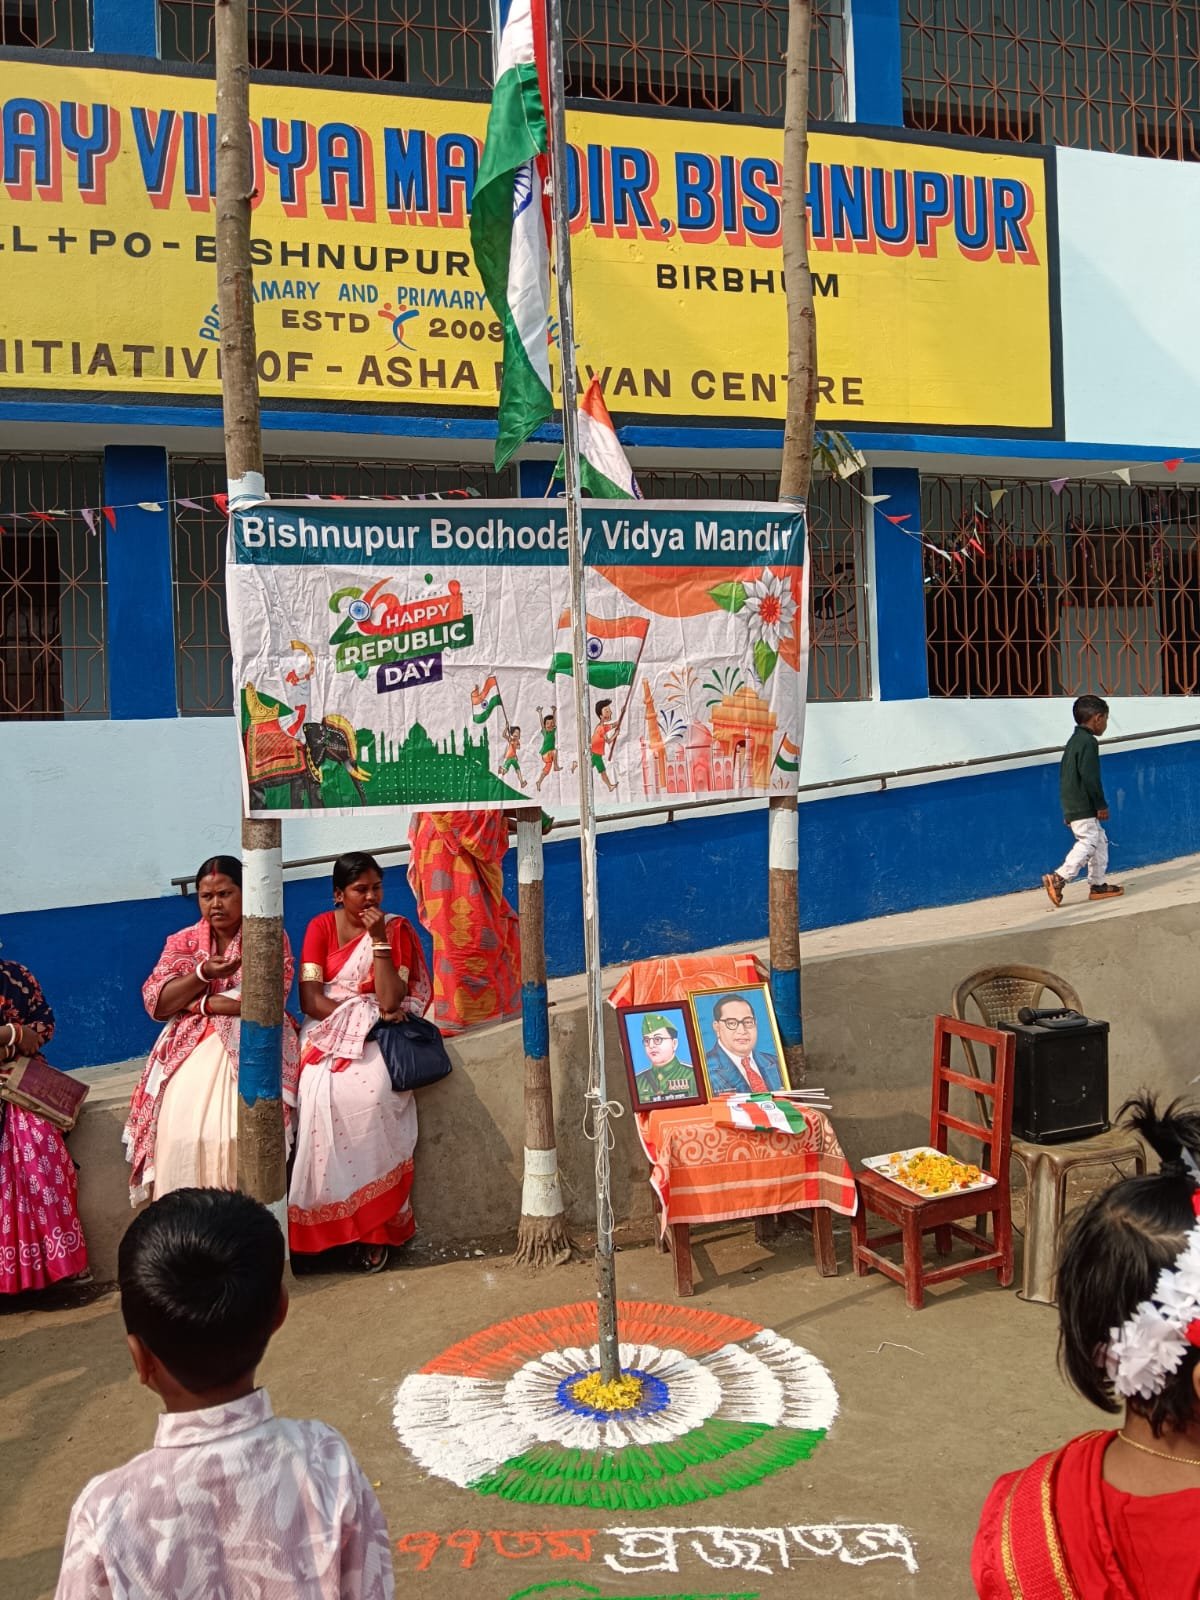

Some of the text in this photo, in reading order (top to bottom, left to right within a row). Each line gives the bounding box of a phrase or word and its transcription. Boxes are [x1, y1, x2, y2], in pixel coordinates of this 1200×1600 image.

[196, 235, 470, 278] BSHNUPUR
[339, 283, 378, 303] AND
[397, 286, 488, 311] PRIMARY
[281, 309, 504, 343] ESTD 2009
[0, 339, 223, 379] ITIATIV
[258, 350, 313, 382] OF
[358, 355, 480, 389] ASHA
[691, 370, 864, 405] CENRE
[242, 517, 420, 556] Bishnupur
[602, 520, 684, 558] Vidya
[695, 521, 792, 551] Mandir
[385, 603, 450, 629] HAPPY
[344, 622, 467, 665] REPUBLIC
[384, 658, 435, 687] DAY
